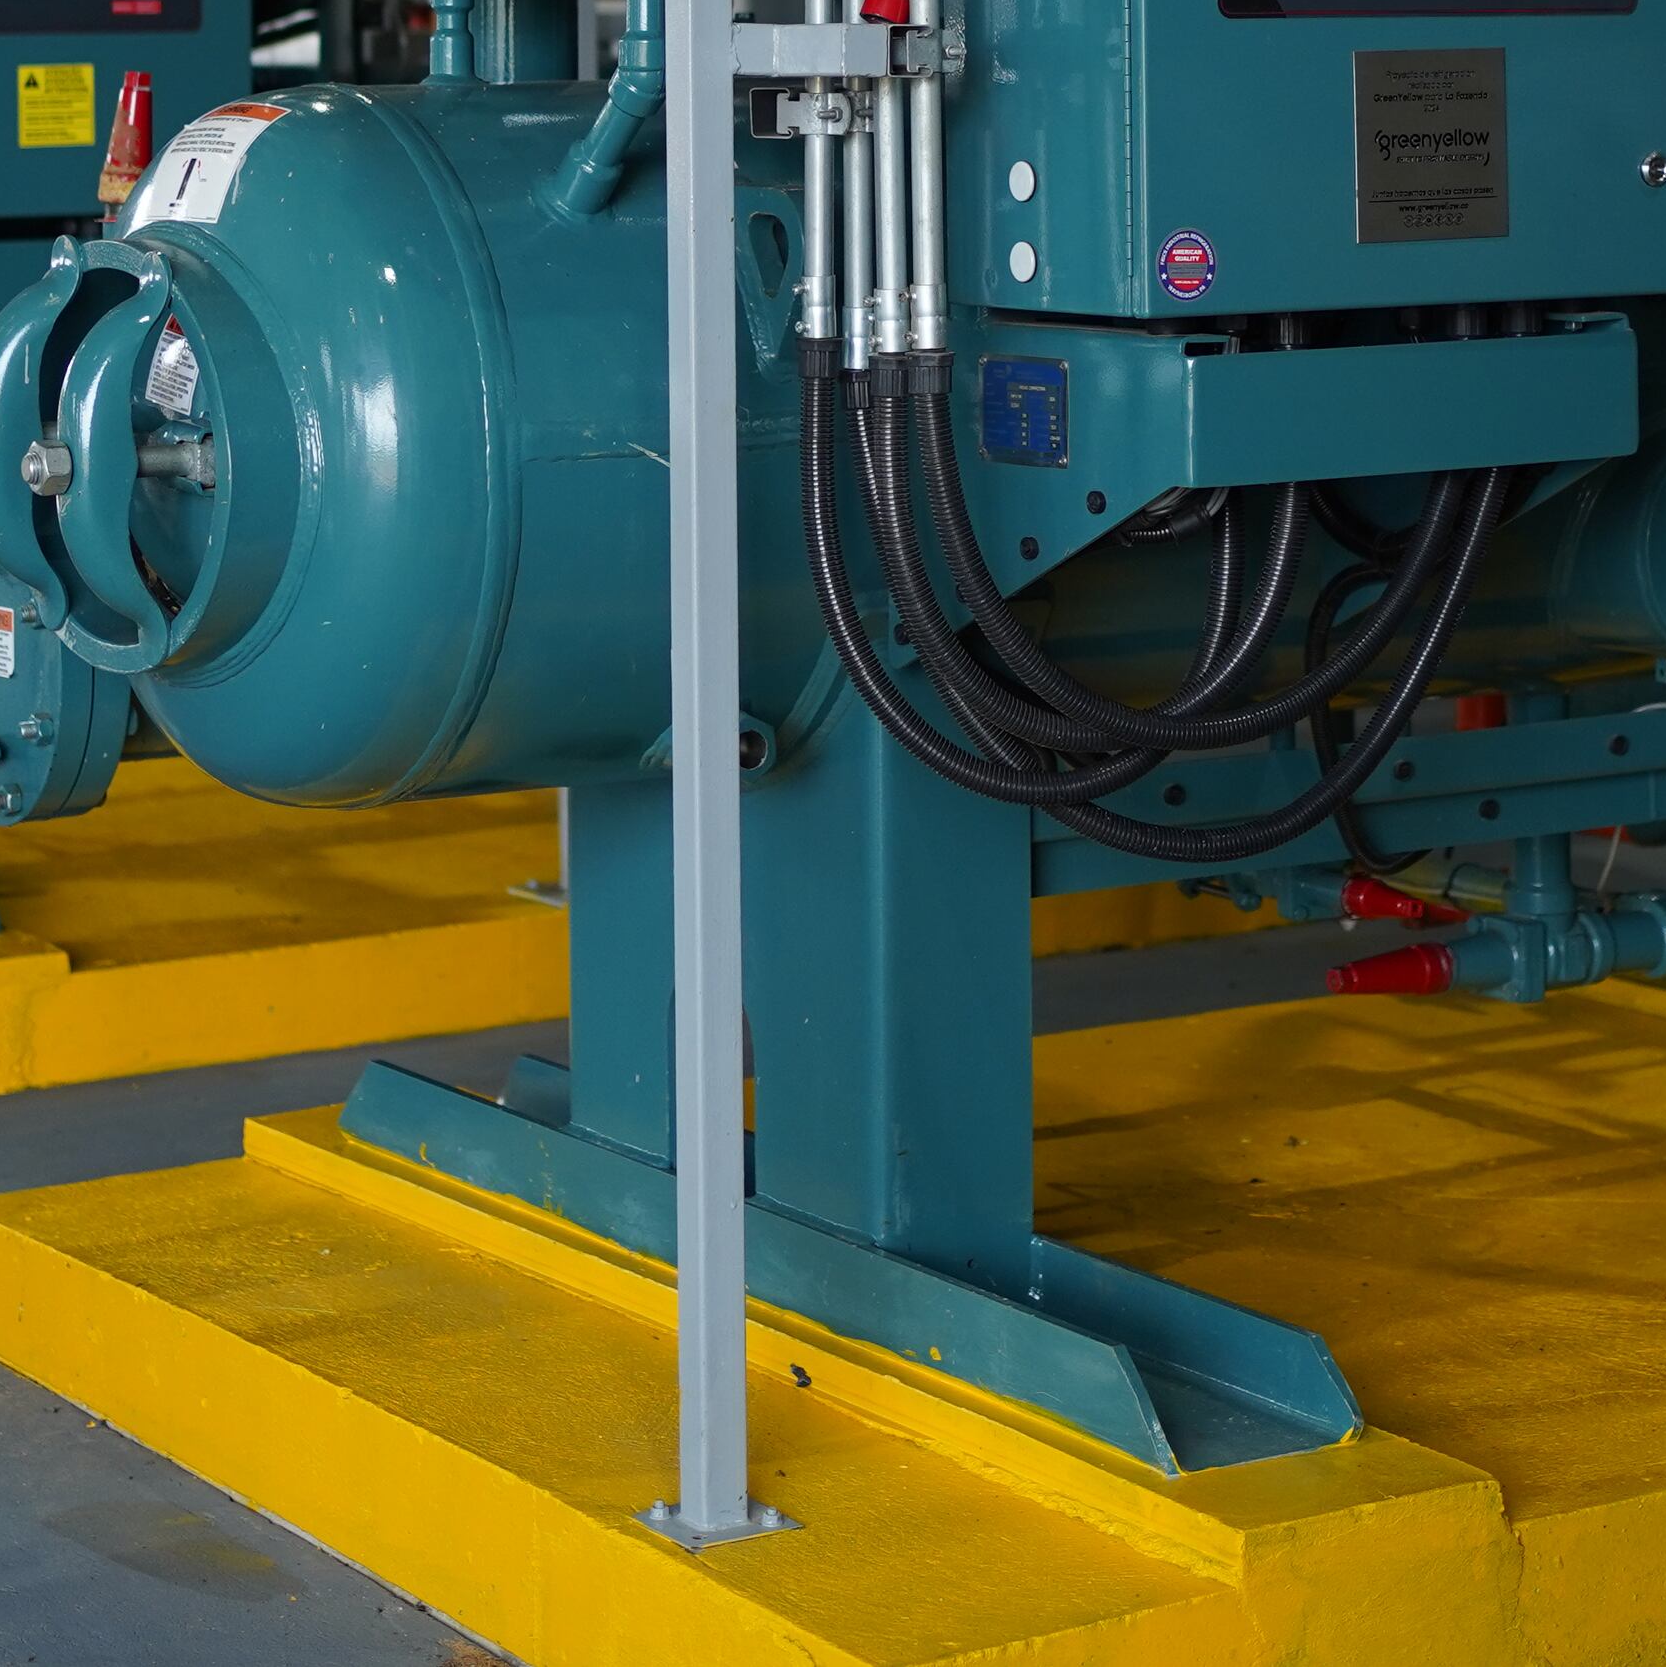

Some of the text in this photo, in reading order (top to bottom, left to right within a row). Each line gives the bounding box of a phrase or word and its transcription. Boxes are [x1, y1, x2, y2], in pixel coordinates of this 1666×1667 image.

[1373, 93, 1423, 103] GreenYellow
[1455, 91, 1488, 100] Fazenda
[1375, 129, 1490, 161] greenyellow
